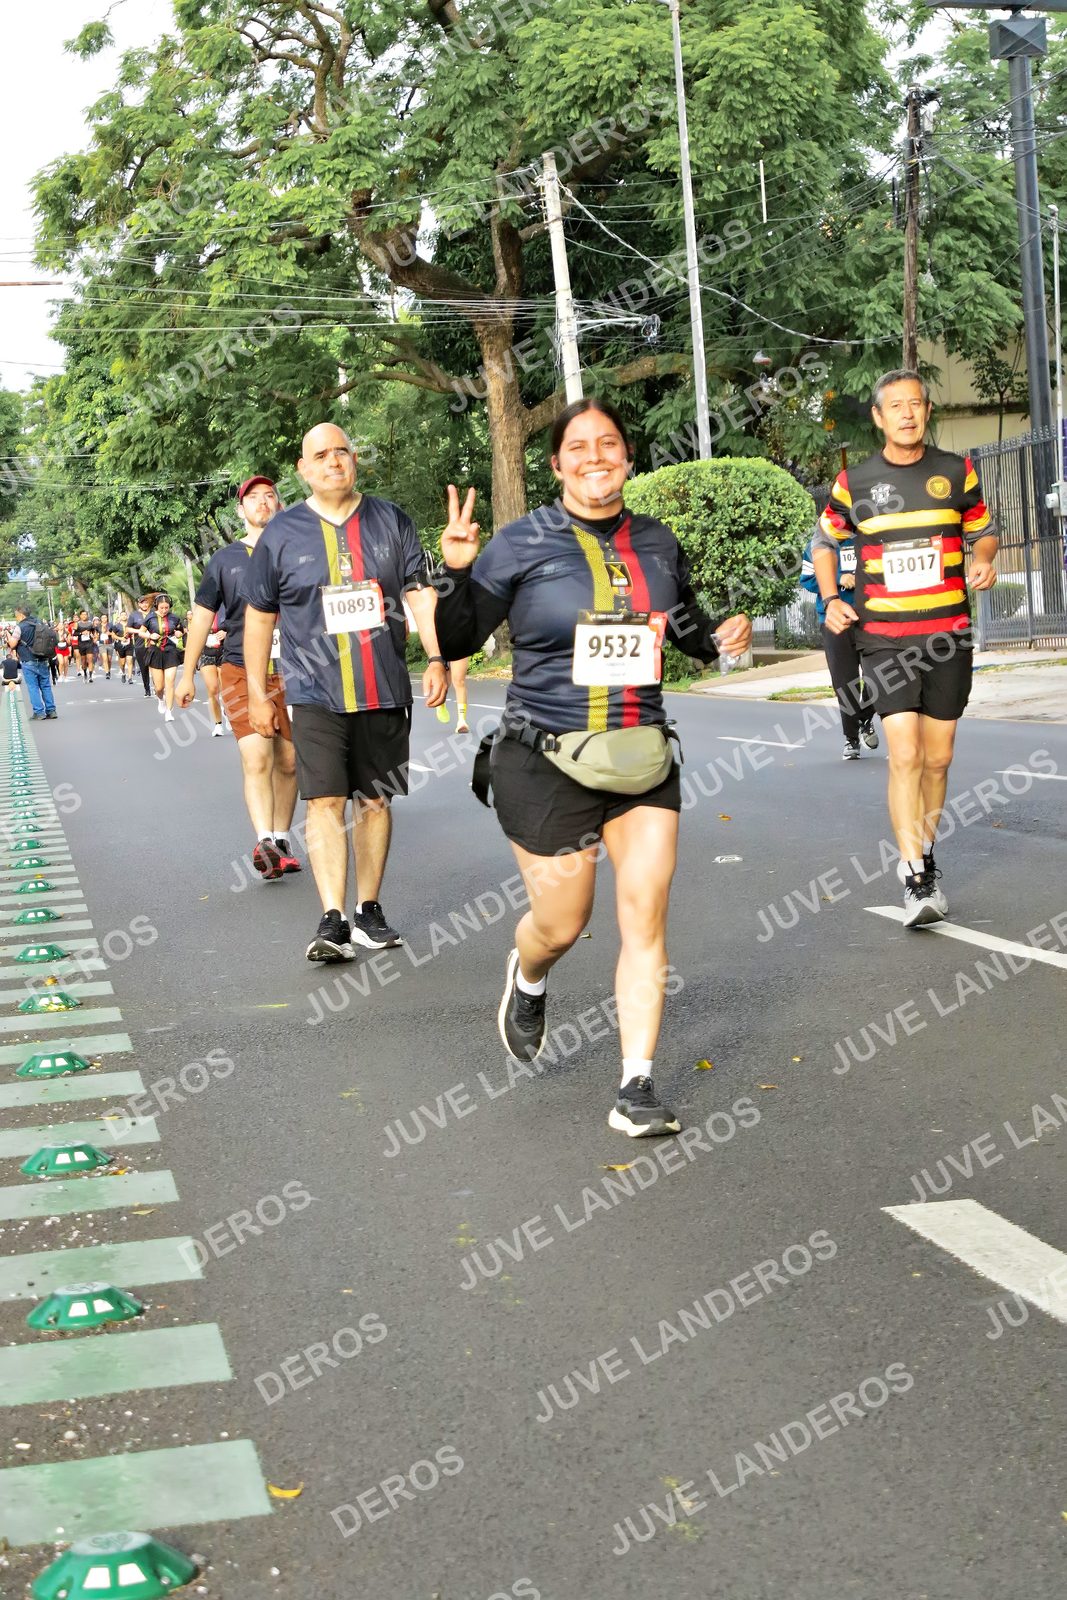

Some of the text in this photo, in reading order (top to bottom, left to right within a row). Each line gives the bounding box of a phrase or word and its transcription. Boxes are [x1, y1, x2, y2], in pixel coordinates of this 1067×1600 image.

[887, 553, 936, 575] 13017
[327, 596, 375, 616] 10893
[588, 634, 641, 658] 9532
